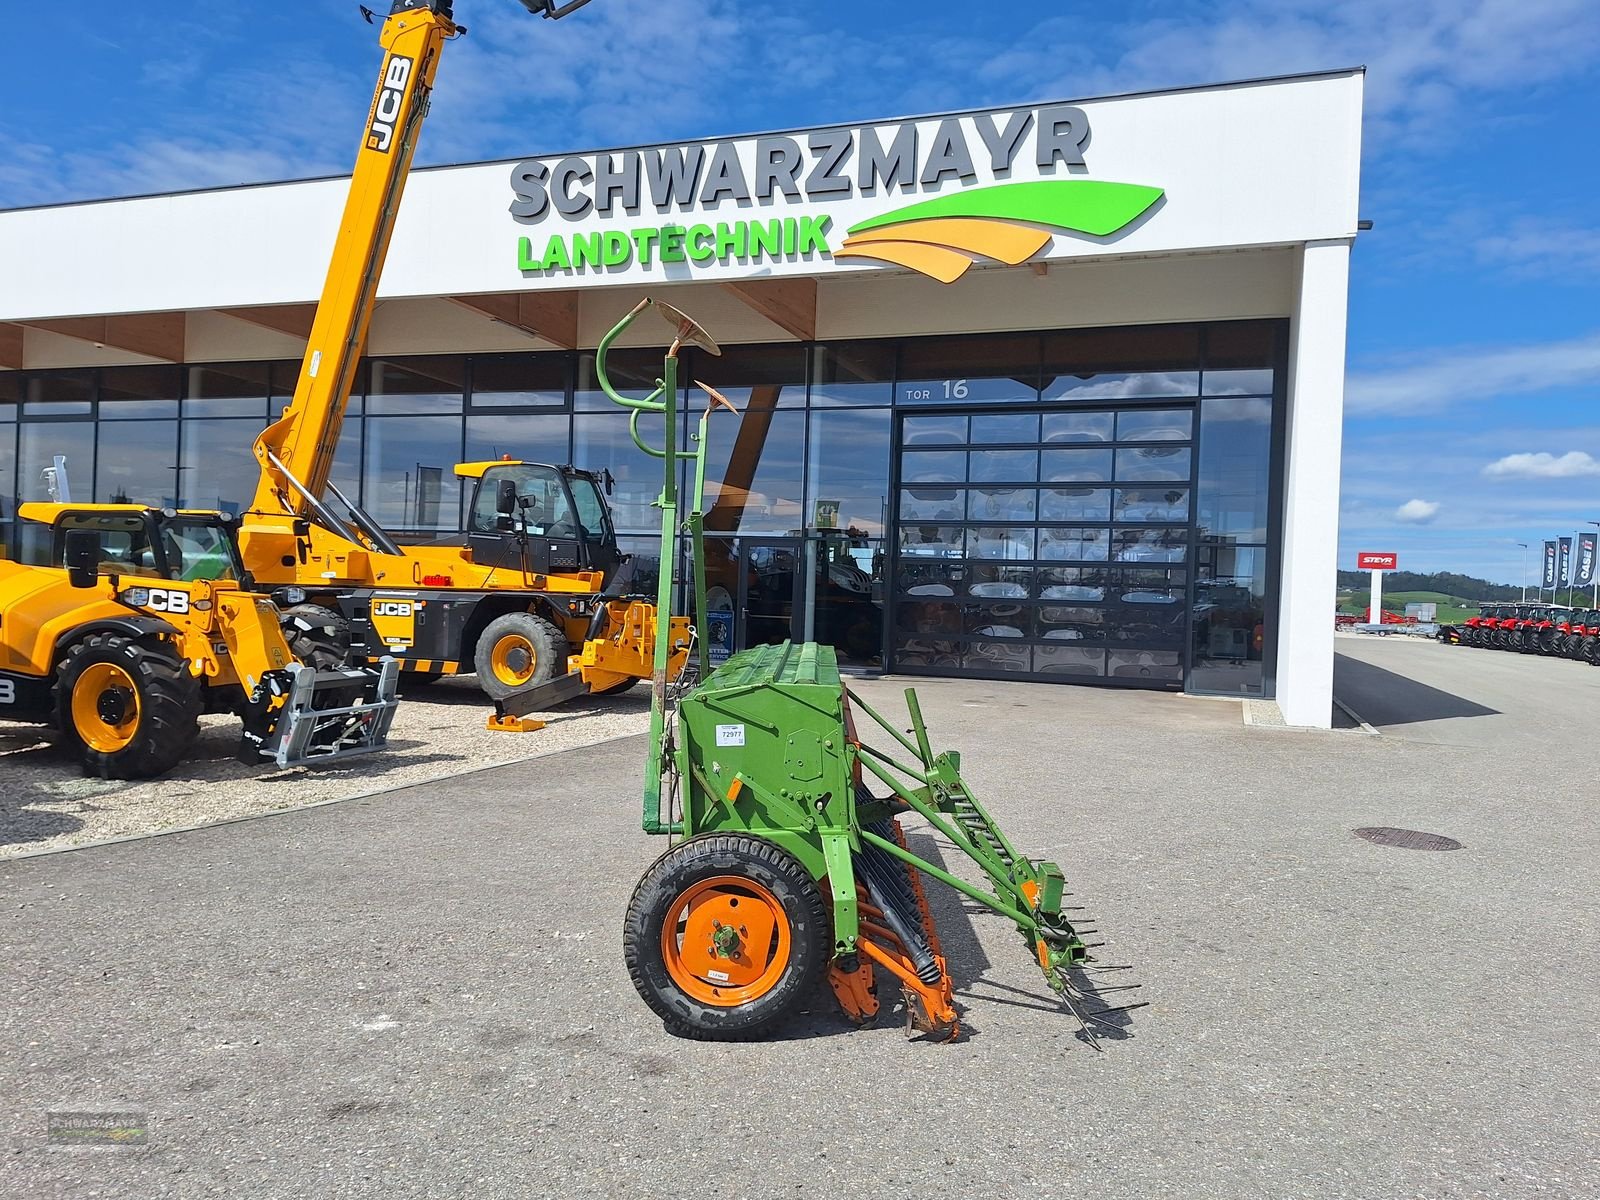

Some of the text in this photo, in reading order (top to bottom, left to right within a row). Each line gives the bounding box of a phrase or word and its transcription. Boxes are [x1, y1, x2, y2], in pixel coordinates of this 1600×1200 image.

[372, 57, 411, 150] JCB
[508, 107, 1091, 219] SCHWARZMAYR
[517, 215, 832, 271] LANDTECHNIK
[906, 379, 968, 399] TOR 16
[147, 589, 189, 613] CB
[374, 602, 411, 616] JCB
